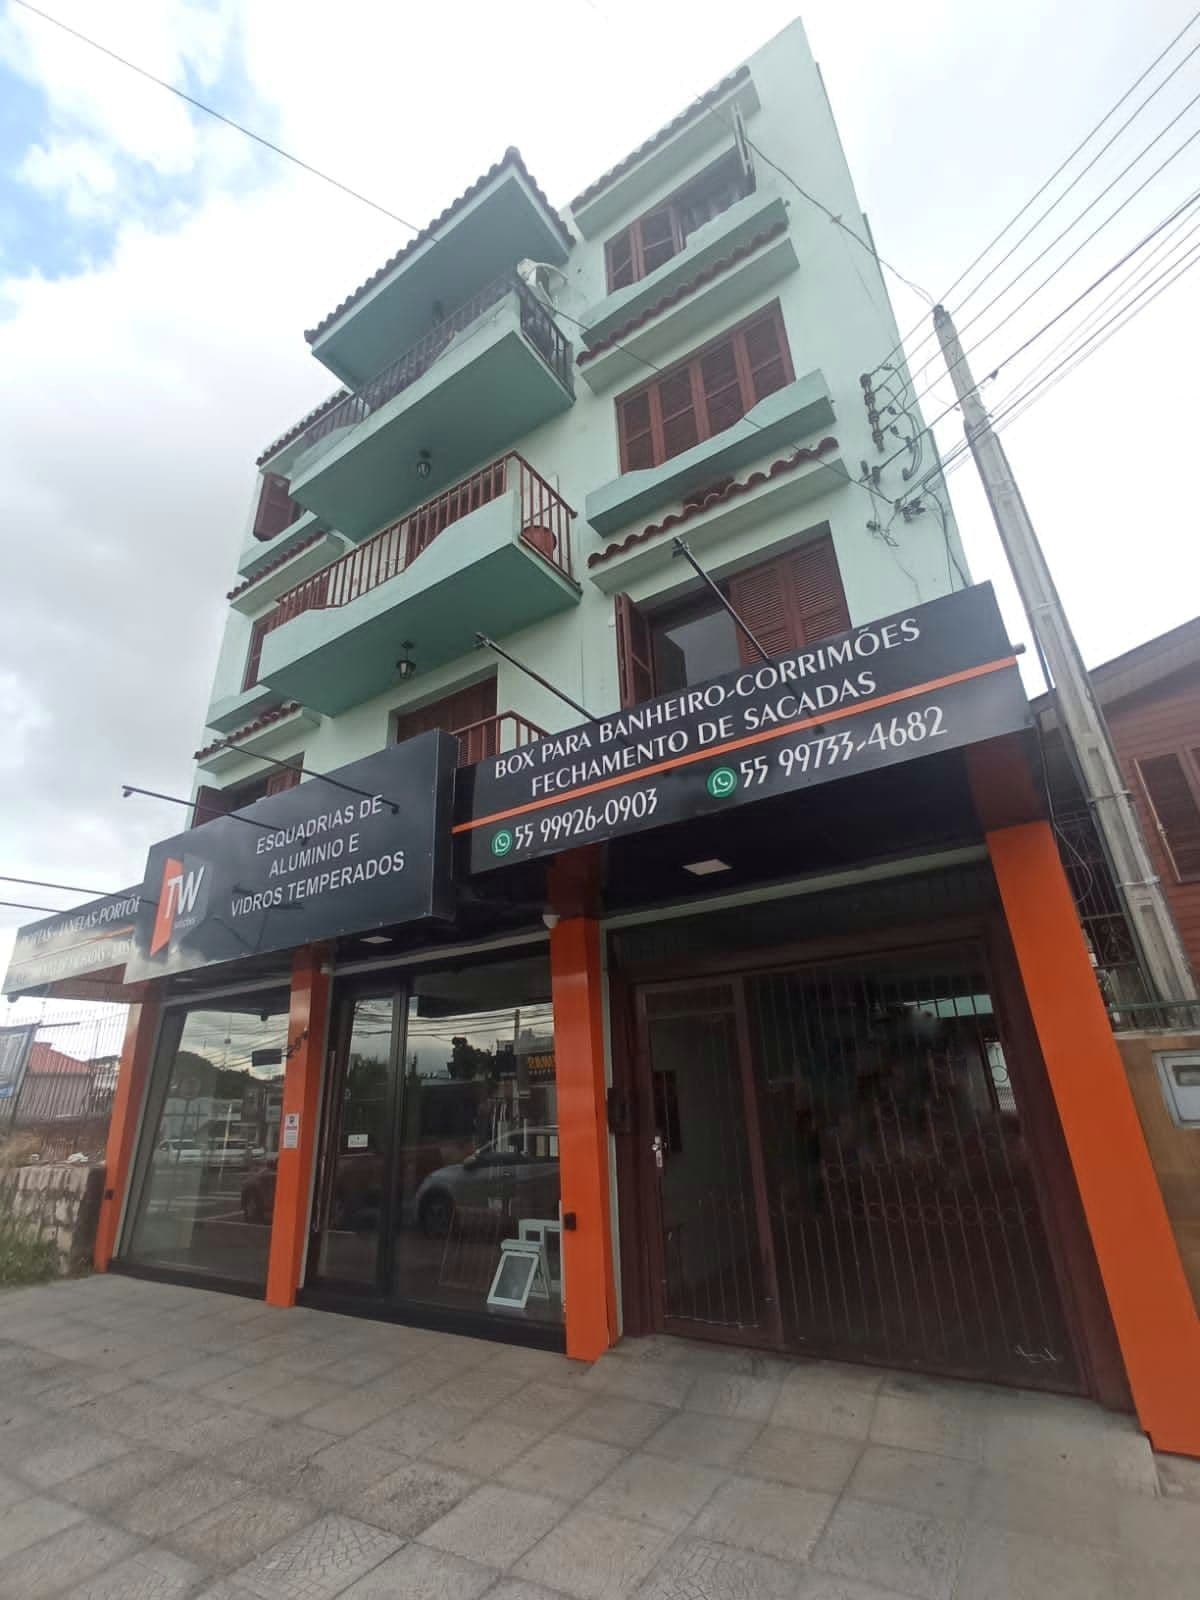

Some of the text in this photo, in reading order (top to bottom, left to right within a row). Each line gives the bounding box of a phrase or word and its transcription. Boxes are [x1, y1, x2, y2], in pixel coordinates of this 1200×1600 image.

[495, 618, 921, 779] BOX PARA BANHEIRO-CORRIMÕES
[532, 671, 876, 797] FECHAMENTO DE SACADAS
[740, 705, 948, 788] 55 99733-4682
[256, 794, 384, 855] ESQUADRIAS DE
[514, 787, 658, 850] 55 99926-0903
[231, 850, 405, 917] VIDROS TEMPERADOS
[268, 833, 360, 878] ALUMINIO E
